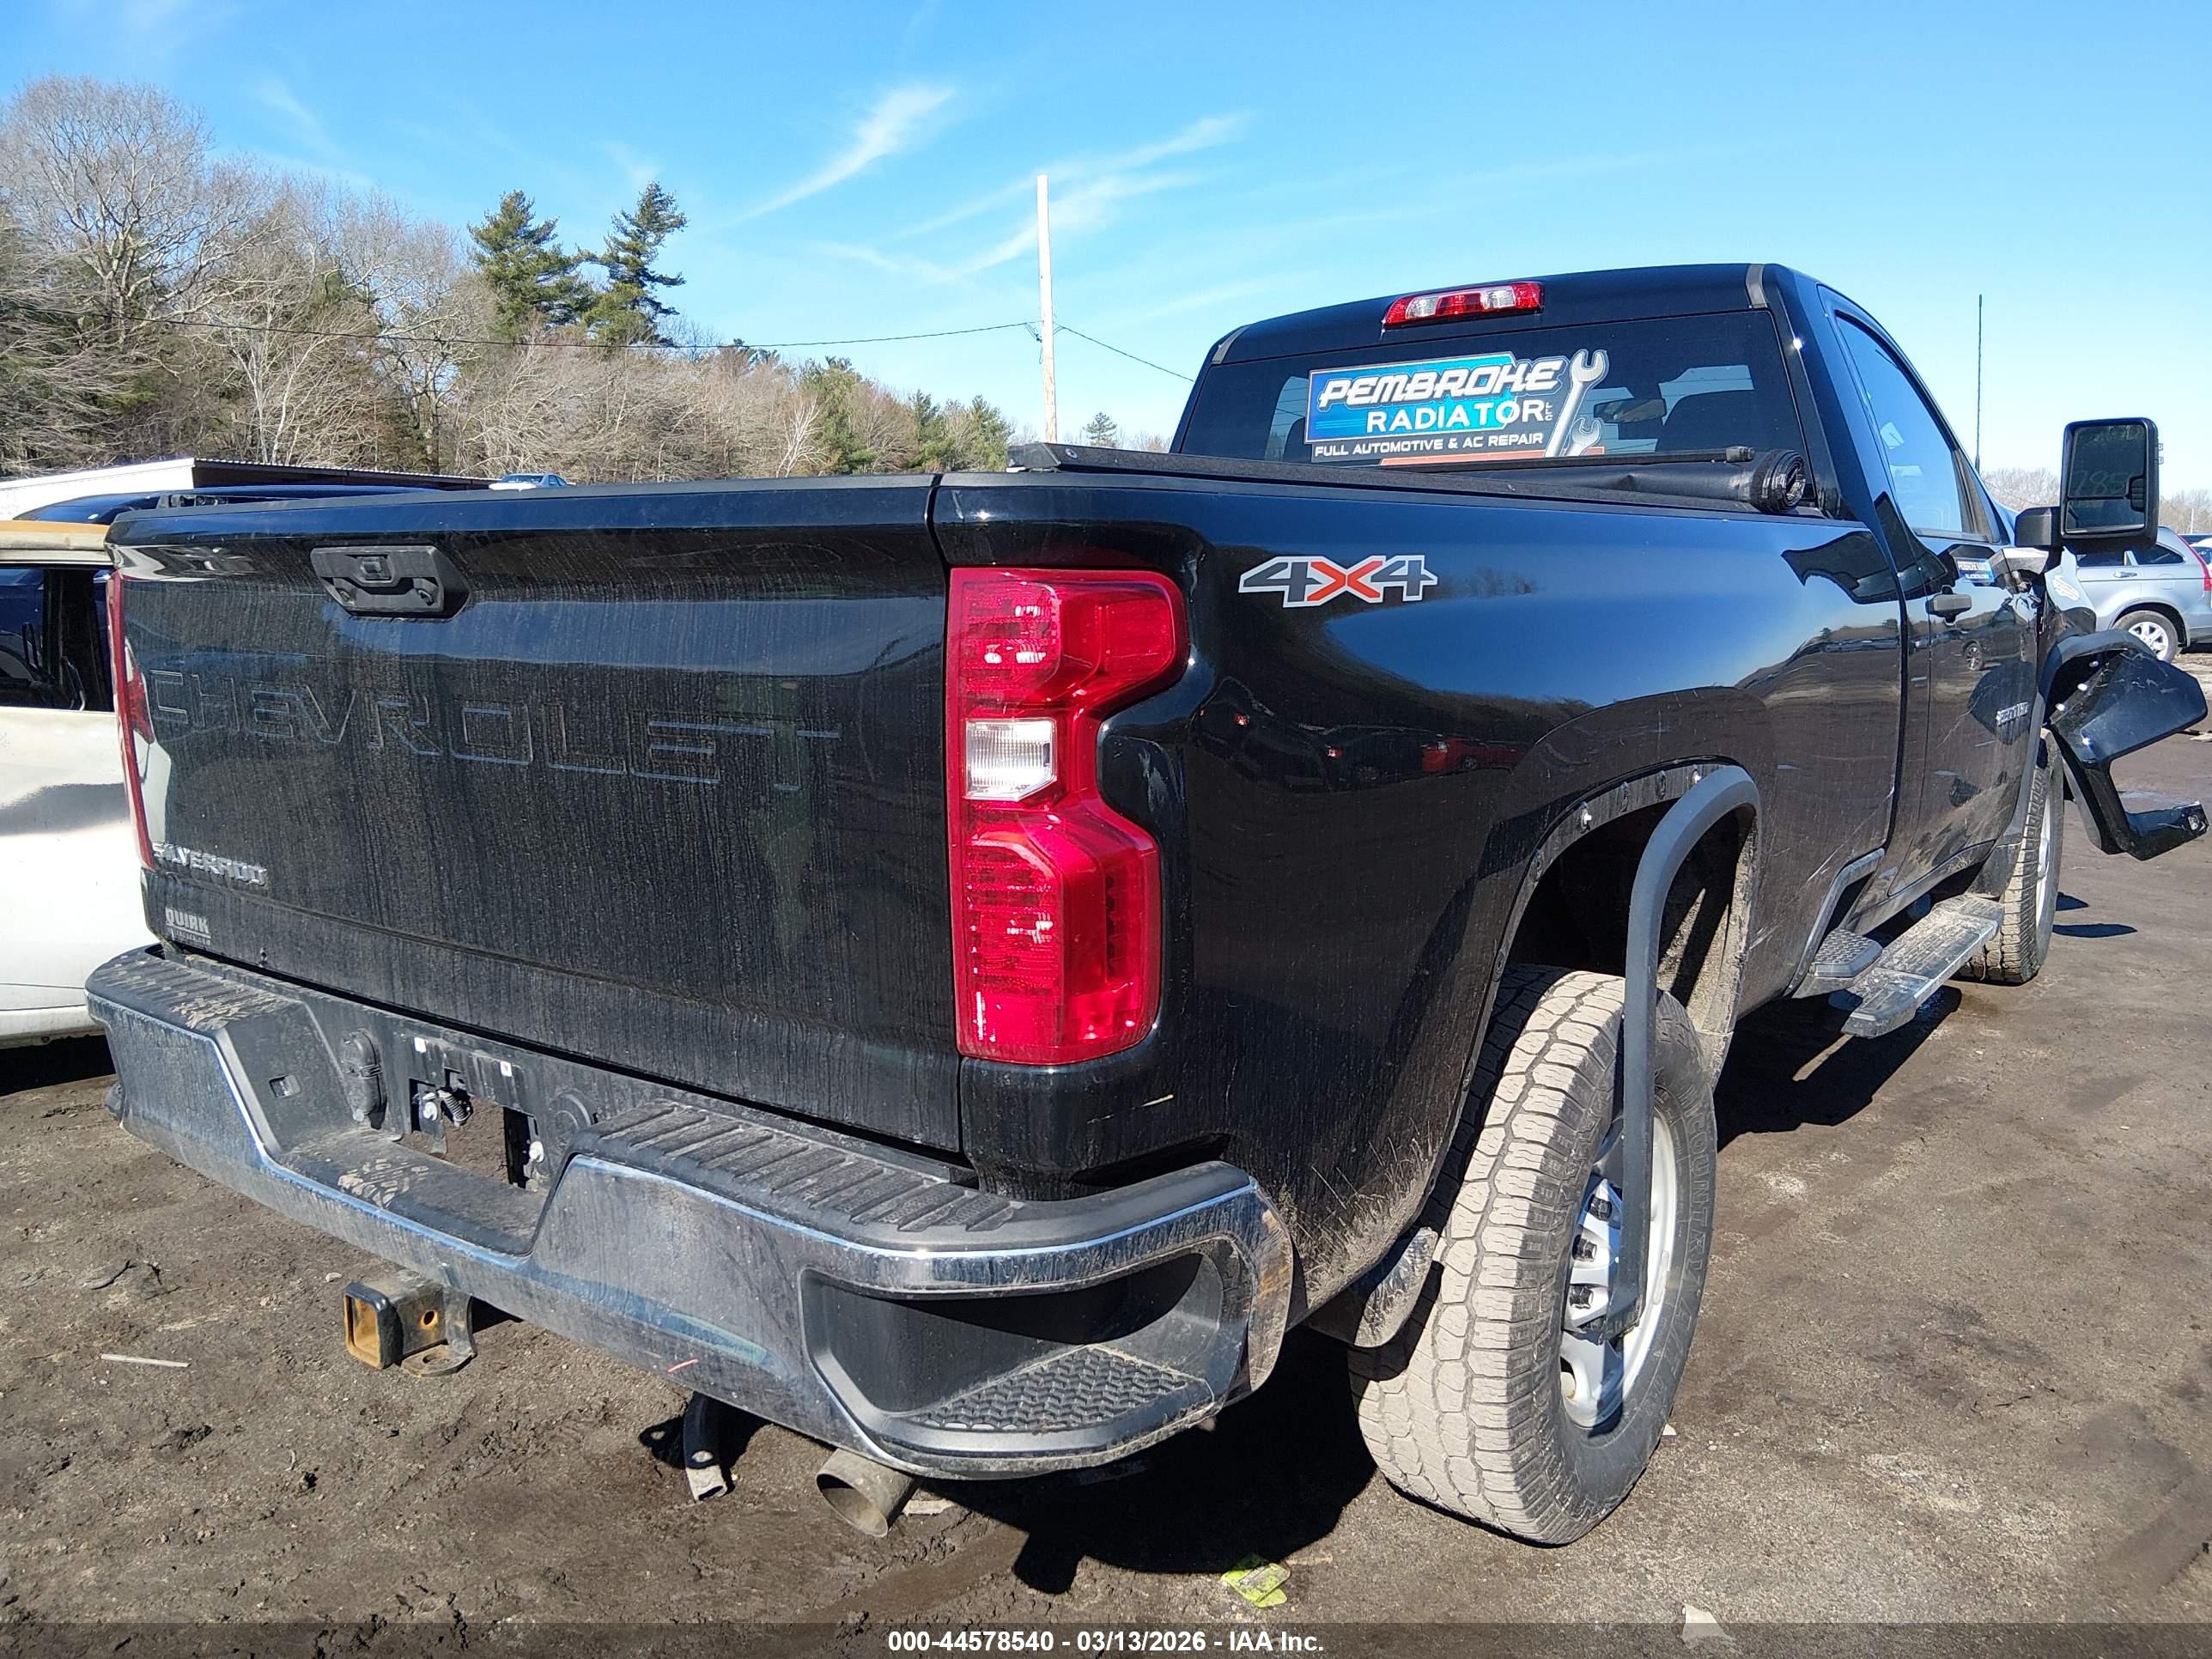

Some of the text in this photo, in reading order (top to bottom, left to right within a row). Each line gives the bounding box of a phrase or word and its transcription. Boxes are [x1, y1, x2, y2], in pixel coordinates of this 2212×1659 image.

[1318, 361, 1563, 408] PEMBROKE
[1367, 399, 1545, 433] RADIATOR
[1545, 401, 1553, 422] LLC
[1315, 432, 1543, 457] FULL AUTOMOTIVE & AC REPAIR
[149, 670, 841, 791] CHEVROLET
[151, 842, 267, 886] SILVERADO
[165, 906, 210, 934] QUIRK
